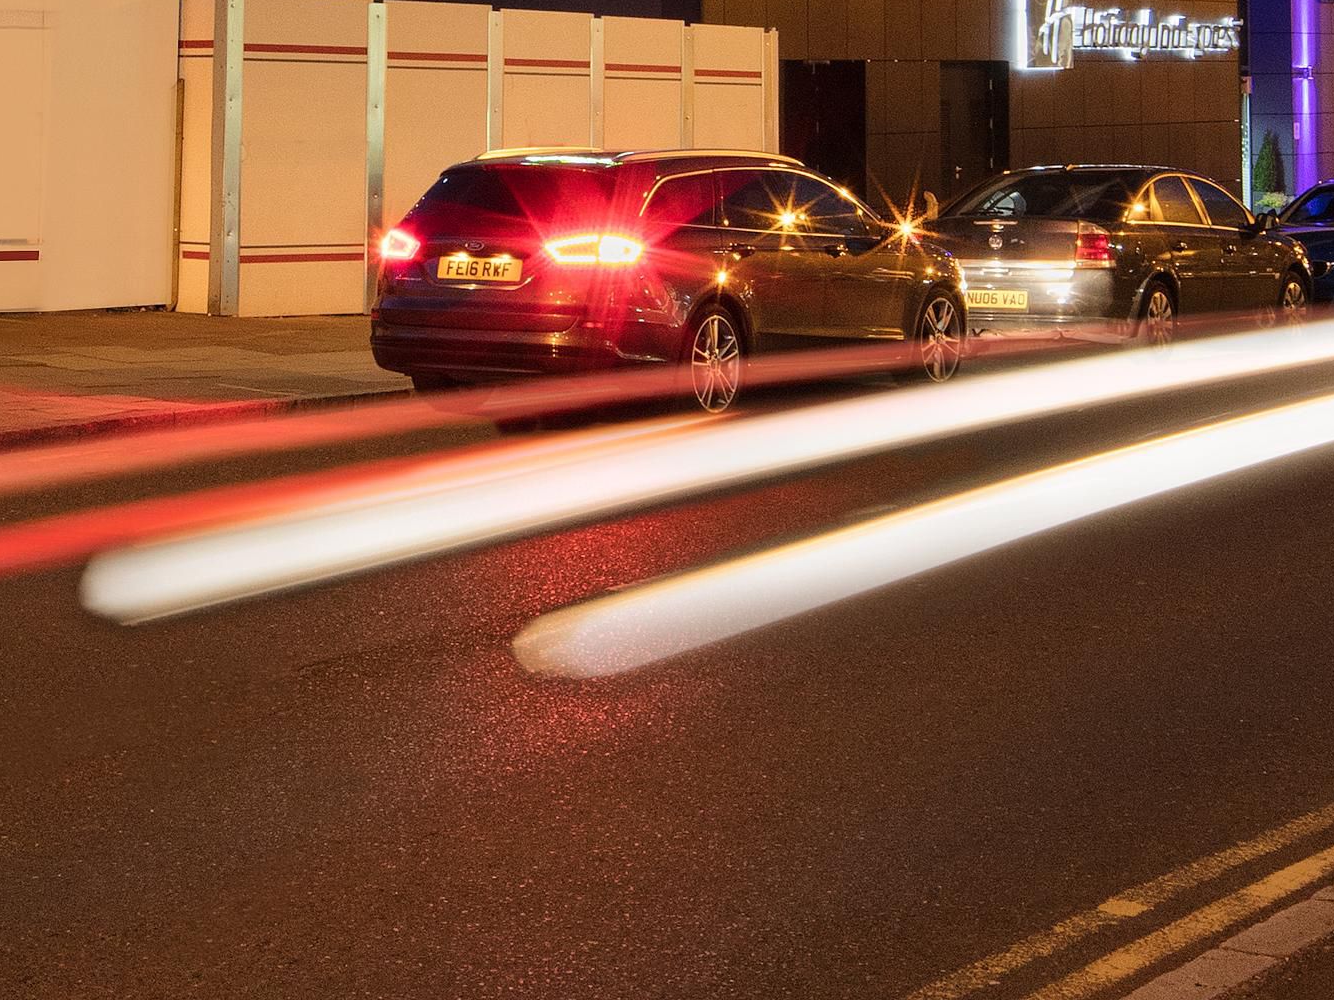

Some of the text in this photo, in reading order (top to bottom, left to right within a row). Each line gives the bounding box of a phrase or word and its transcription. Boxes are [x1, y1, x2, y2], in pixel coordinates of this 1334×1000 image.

[447, 261, 512, 277] FE16 RWF
[967, 292, 998, 304] NU06
